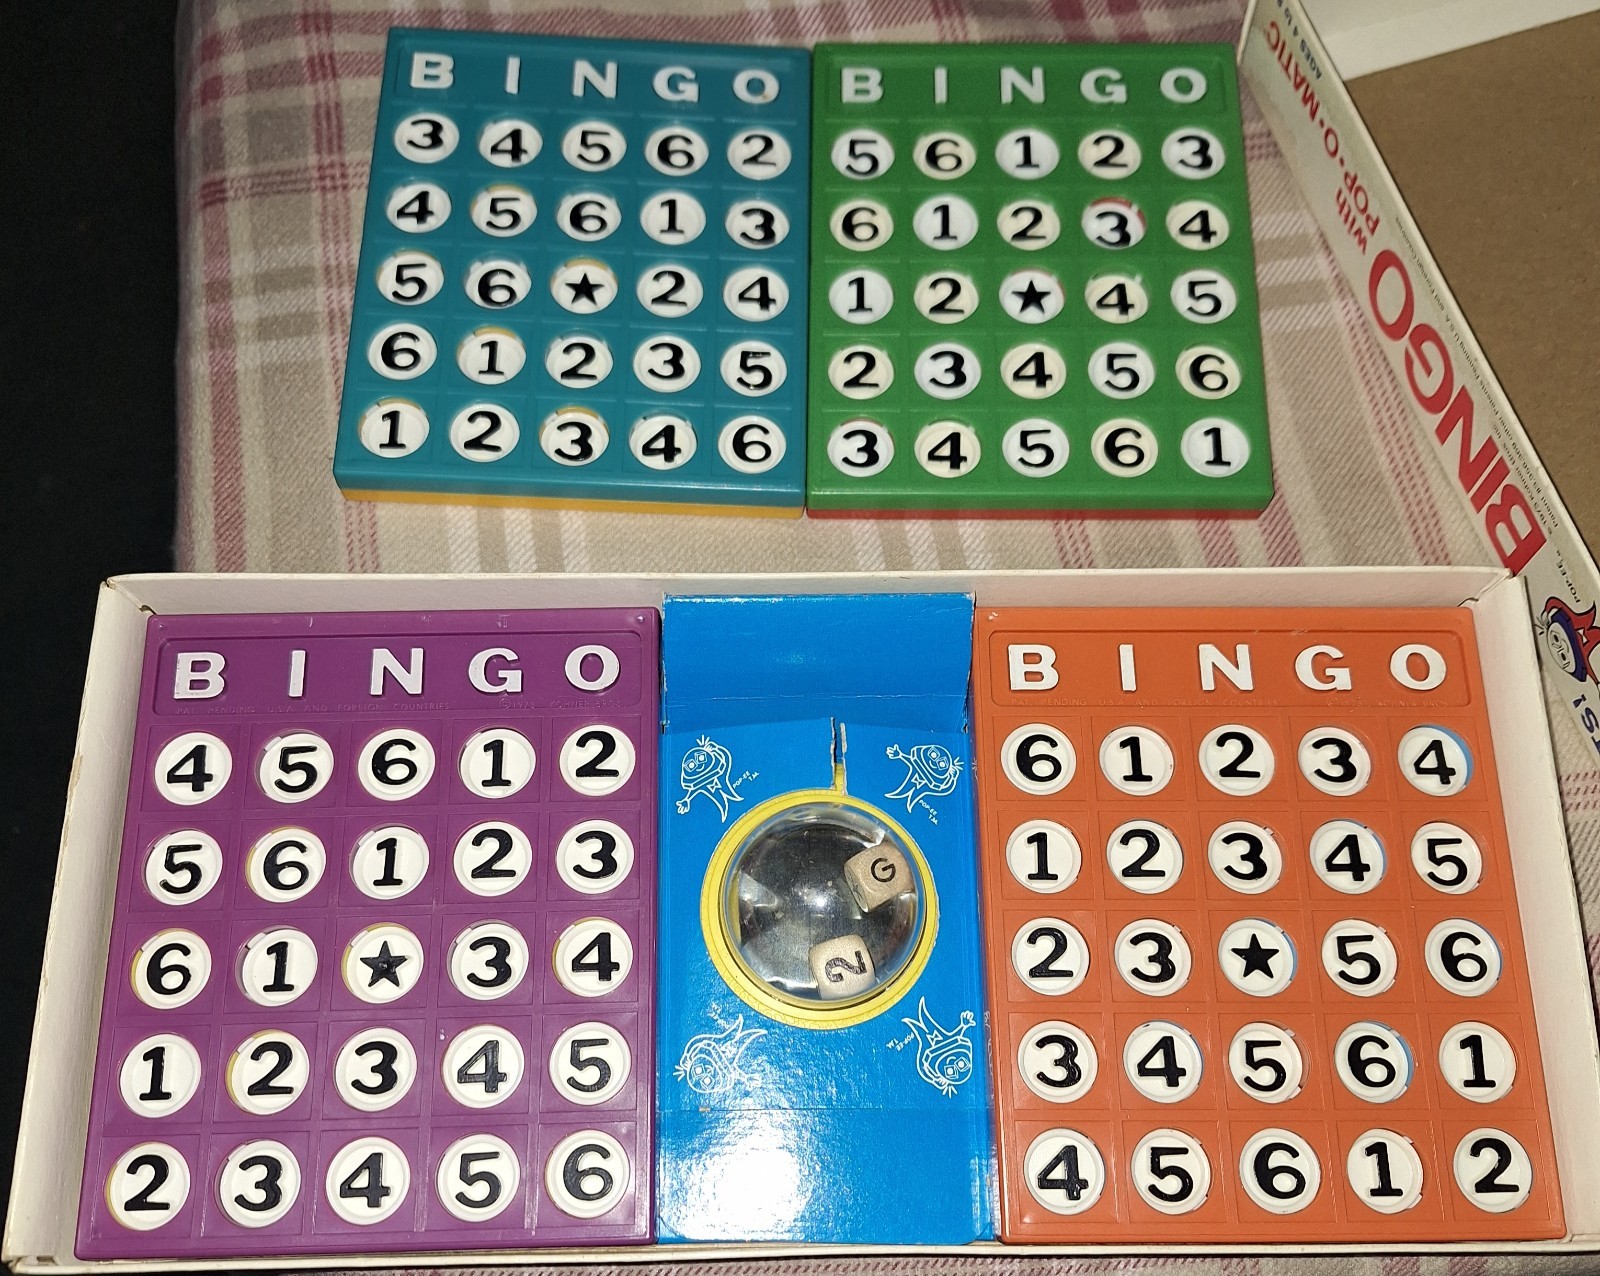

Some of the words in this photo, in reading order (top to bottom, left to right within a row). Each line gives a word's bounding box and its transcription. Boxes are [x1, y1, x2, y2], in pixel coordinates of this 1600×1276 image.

[407, 119, 443, 149] 3
[491, 129, 527, 162] 4
[577, 130, 611, 164] 5
[658, 135, 694, 169] 6
[743, 135, 775, 165] 2
[846, 139, 878, 176] 5
[926, 140, 962, 171] 6
[1016, 136, 1039, 167] 1
[1094, 136, 1127, 167] 2
[1178, 136, 1212, 170] 3
[397, 191, 434, 224] 4
[486, 198, 521, 230] 5
[570, 201, 607, 234] 6
[661, 199, 684, 233] 1
[740, 208, 775, 244] 3
[842, 208, 878, 242] 6
[934, 205, 957, 239] 1
[1012, 207, 1046, 241] 2
[1096, 212, 1131, 247] 3
[1179, 210, 1216, 243] 4
[392, 264, 427, 302] 5
[478, 269, 517, 307] 6
[652, 271, 687, 306] 2
[739, 277, 776, 310] 4
[849, 277, 872, 312] 1
[929, 278, 964, 314] 2
[1096, 284, 1134, 315] 4
[1188, 281, 1221, 316] 5
[381, 332, 420, 371] 6
[479, 341, 504, 375] 1
[561, 343, 597, 380] 2
[648, 343, 685, 379] 3
[737, 351, 772, 390] 5
[844, 352, 879, 388] 2
[930, 351, 966, 388] 3
[1013, 352, 1052, 387] 4
[1105, 353, 1139, 391] 5
[1190, 354, 1228, 391] 6
[379, 411, 406, 448] 1
[464, 411, 501, 452] 2
[555, 422, 593, 461] 3
[642, 425, 681, 462] 4
[733, 424, 771, 462] 6
[1369, 249, 1547, 577] BINGO
[842, 430, 879, 468] 3
[928, 432, 967, 469] 4
[1019, 430, 1054, 468] 5
[1104, 428, 1144, 467] 6
[1204, 427, 1231, 466] 1
[167, 745, 213, 792] 4
[275, 746, 317, 793] 5
[372, 739, 417, 785] 6
[482, 740, 511, 787] 1
[576, 731, 619, 777] 2
[1016, 734, 1061, 782] 6
[1120, 737, 1152, 782] 1
[1216, 732, 1260, 778] 2
[1312, 738, 1356, 782] 3
[1414, 740, 1456, 784] 4
[160, 844, 202, 894] 5
[264, 840, 309, 890] 6
[373, 838, 403, 886] 1
[471, 829, 516, 878] 2
[573, 831, 617, 879] 3
[870, 857, 897, 883] G
[1027, 832, 1058, 880] 1
[1120, 829, 1165, 877] 2
[1222, 833, 1267, 880] 3
[1325, 834, 1370, 881] 4
[1427, 838, 1467, 886] 5
[147, 943, 191, 995] 6
[263, 942, 294, 992] 1
[467, 937, 511, 987] 3
[572, 932, 620, 981] 4
[824, 950, 867, 983] 2
[1027, 927, 1073, 978] 2
[1130, 932, 1175, 983] 3
[1337, 935, 1381, 985] 5
[1441, 932, 1487, 982] 6
[139, 1047, 171, 1101] 1
[248, 1041, 294, 1096] 2
[351, 1041, 397, 1095] 3
[457, 1040, 507, 1093] 4
[567, 1039, 611, 1092] 5
[1036, 1035, 1081, 1088] 3
[1137, 1036, 1186, 1087] 4
[1244, 1040, 1286, 1092] 5
[1348, 1035, 1396, 1087] 6
[1460, 1035, 1496, 1088] 1
[124, 1155, 170, 1211] 2
[235, 1156, 282, 1211] 3
[340, 1153, 390, 1208] 4
[456, 1152, 501, 1208] 5
[563, 1144, 613, 1201] 6
[1038, 1145, 1088, 1200] 4
[1148, 1147, 1193, 1202] 5
[1254, 1143, 1306, 1199] 6
[1365, 1142, 1403, 1196] 1
[1470, 1138, 1519, 1193] 2
